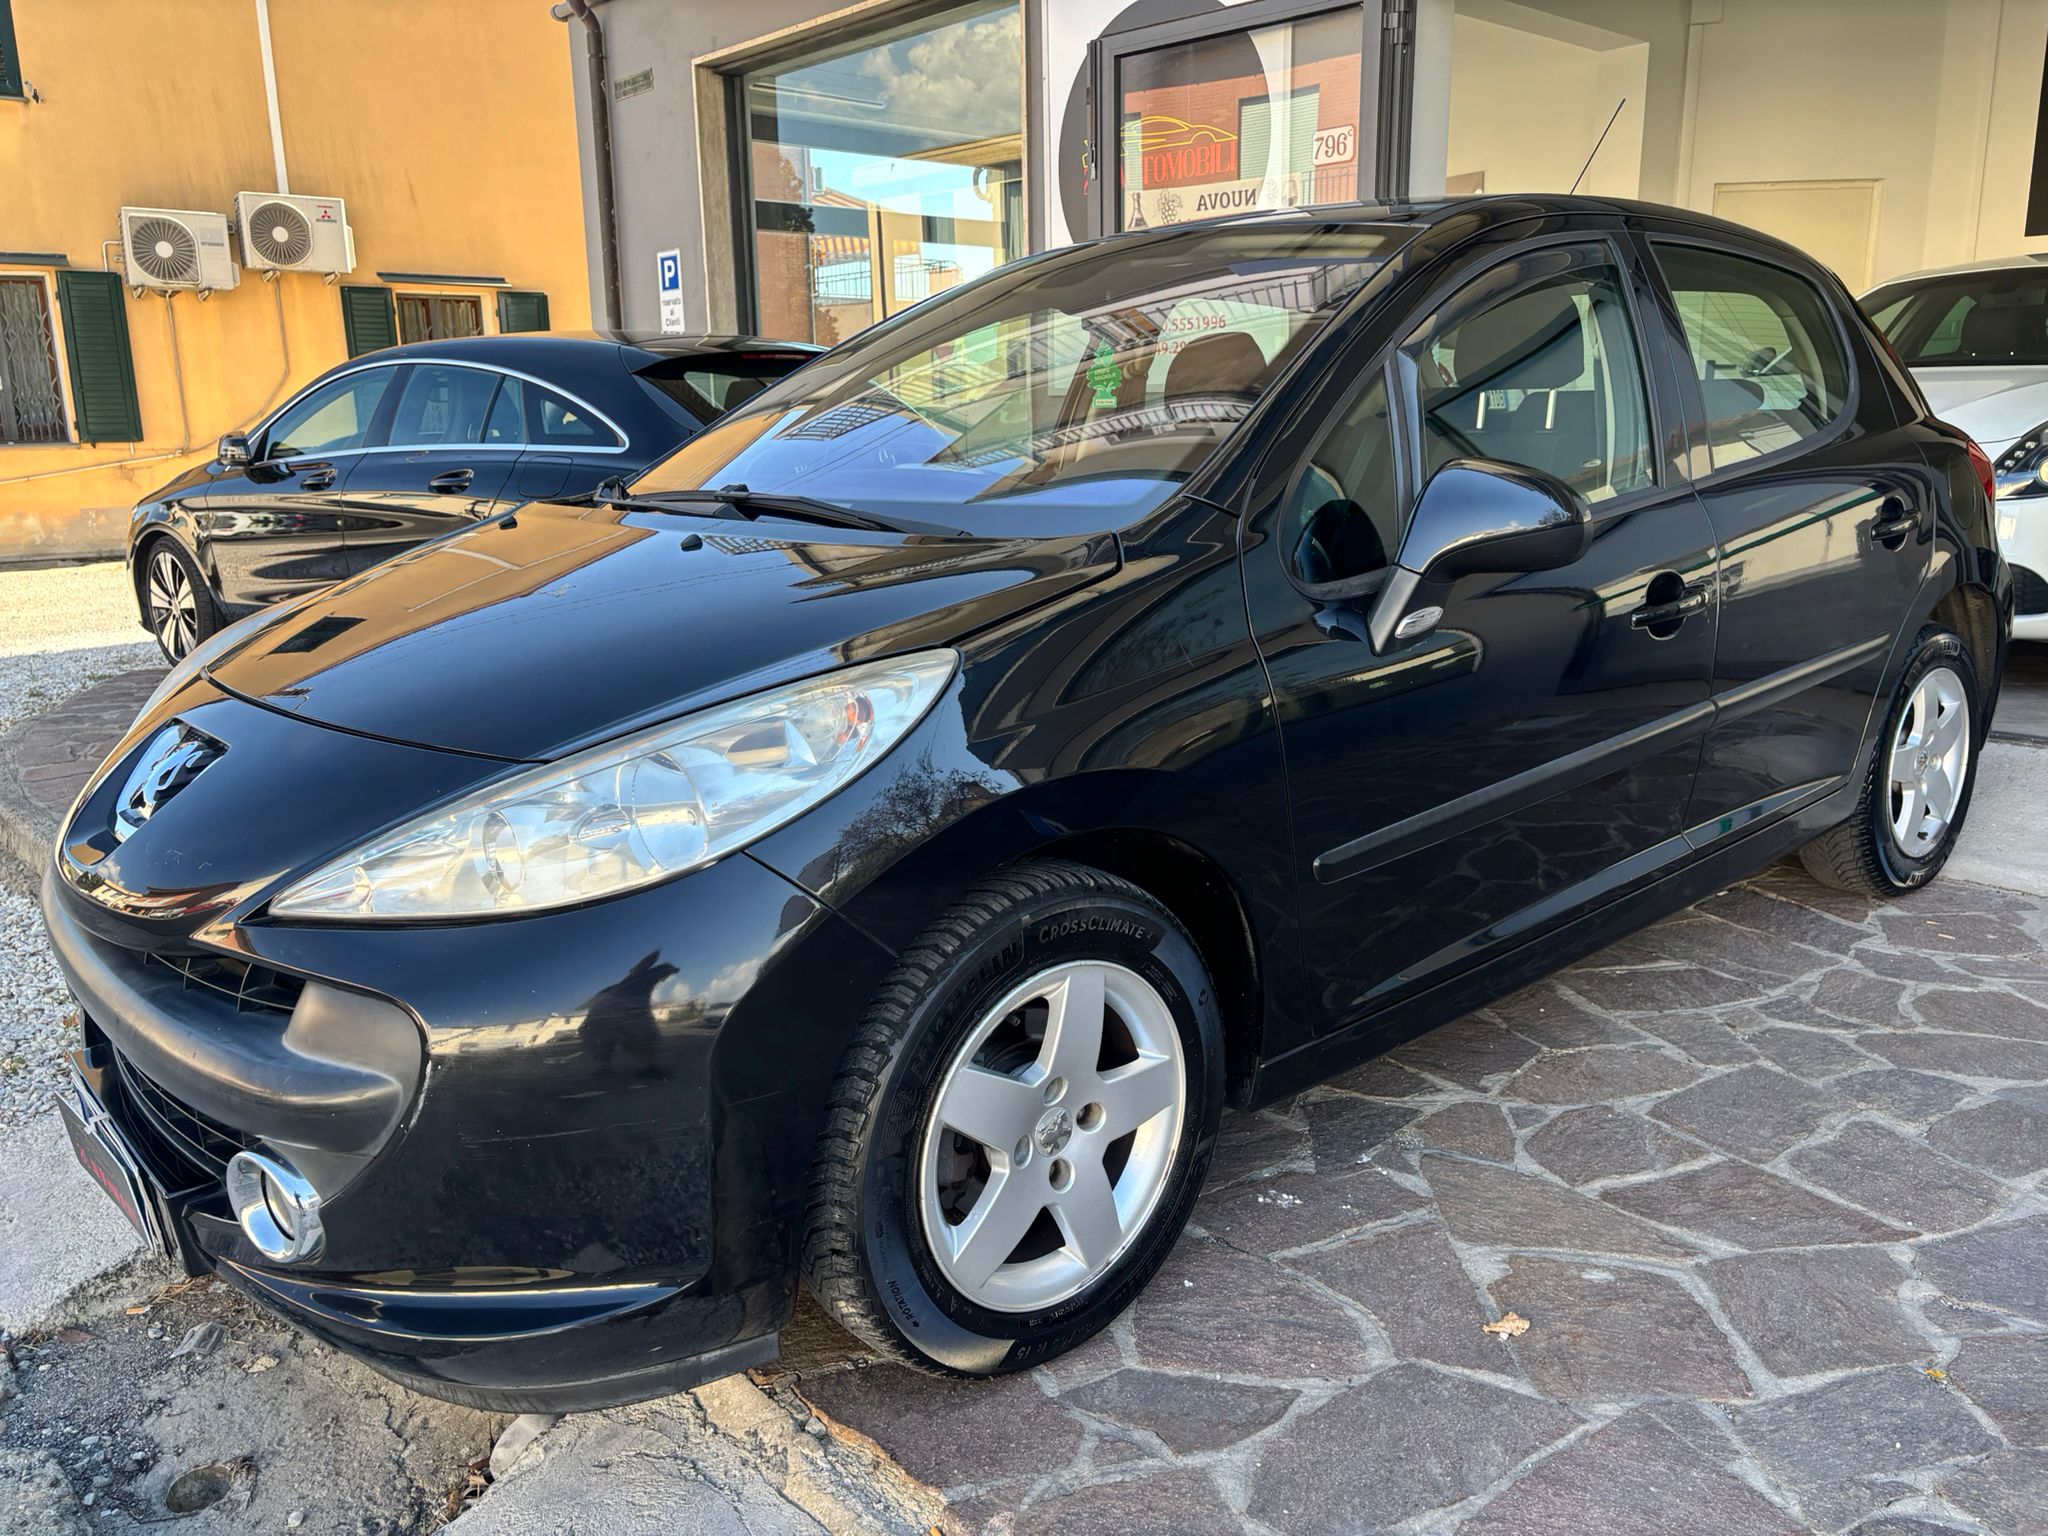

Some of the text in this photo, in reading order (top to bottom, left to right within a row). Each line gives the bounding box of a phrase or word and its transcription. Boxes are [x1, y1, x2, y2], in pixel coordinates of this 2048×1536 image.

[1121, 139, 1237, 188] TOMOBILI
[663, 260, 676, 288] P
[887, 1280, 914, 1321] ROTATION
